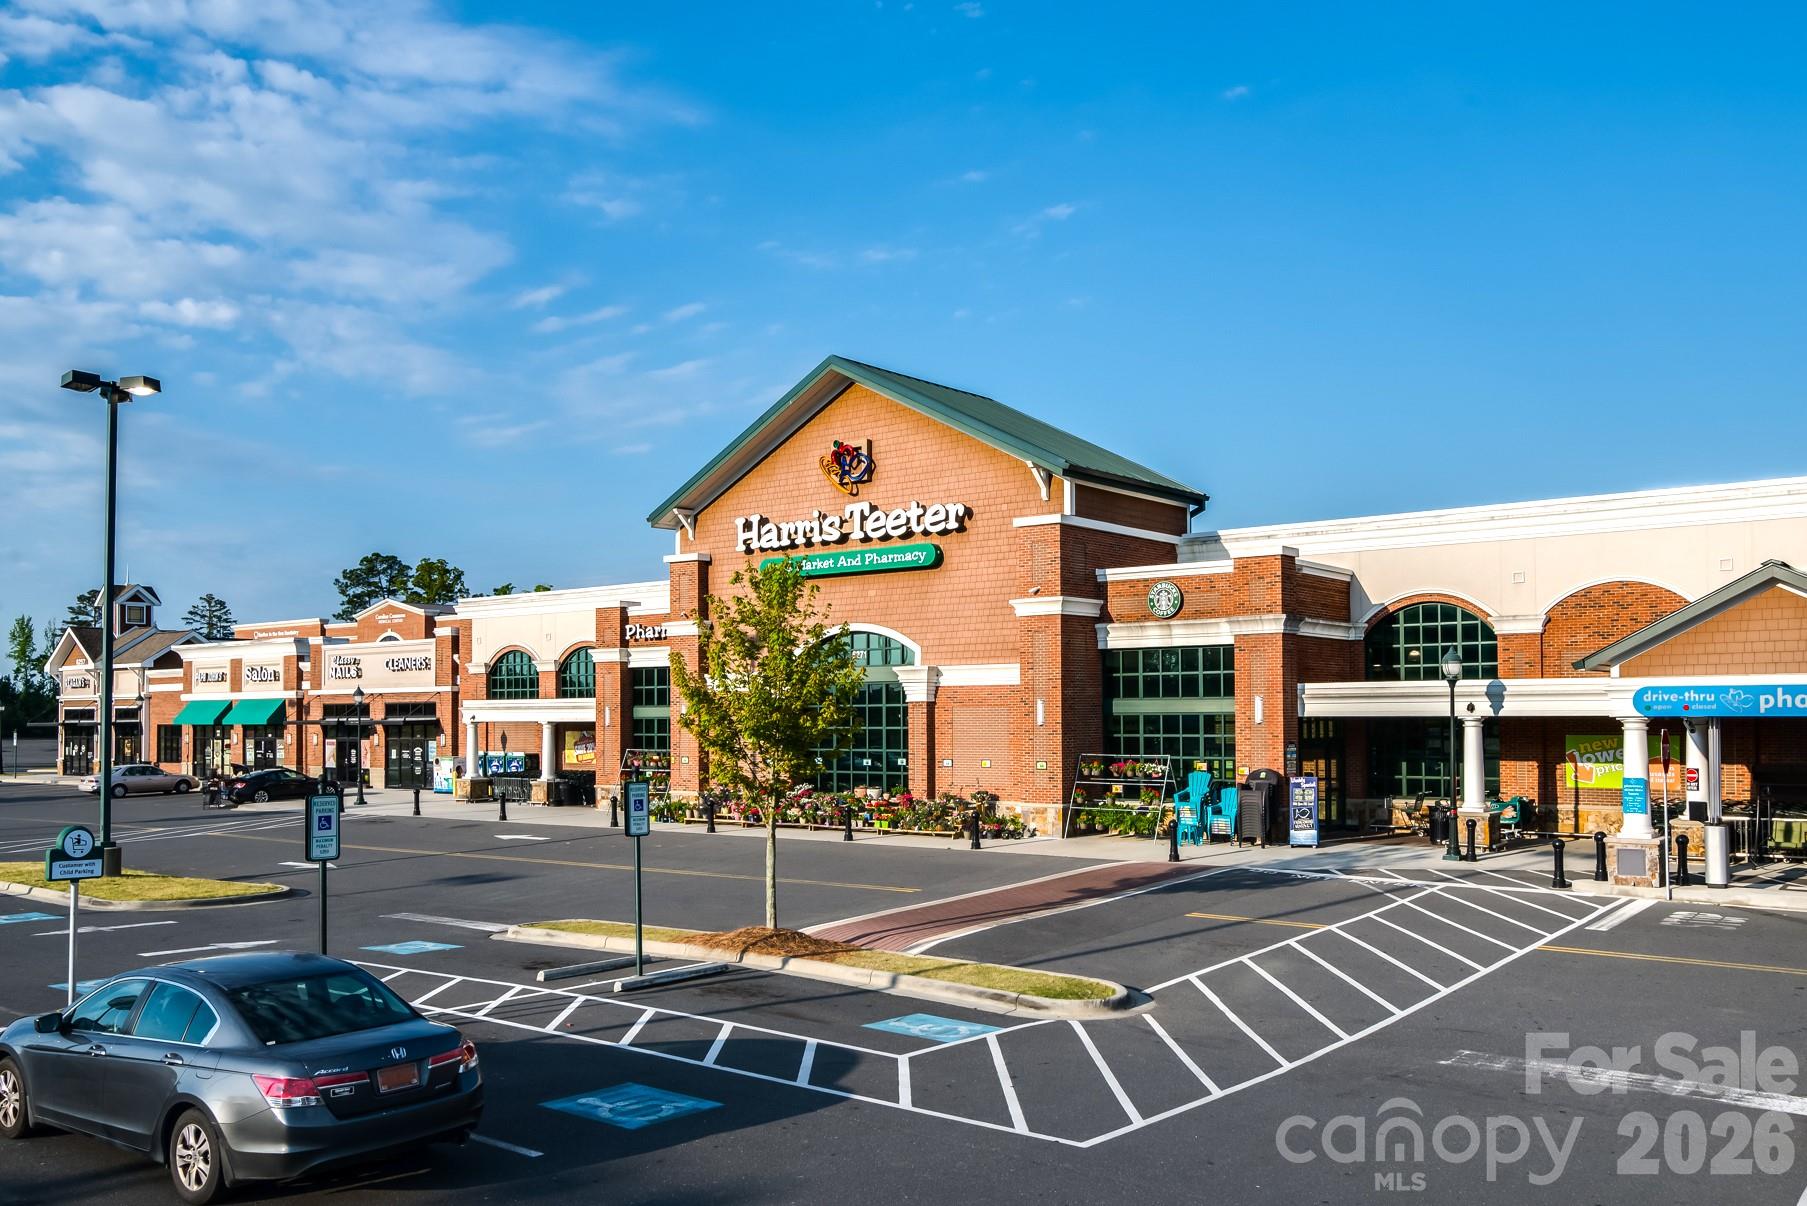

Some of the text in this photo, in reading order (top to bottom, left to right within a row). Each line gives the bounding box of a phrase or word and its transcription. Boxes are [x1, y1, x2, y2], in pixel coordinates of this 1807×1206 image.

[735, 501, 967, 552] Harris Teeter
[837, 554, 862, 567] And
[865, 551, 926, 565] Pharmacy
[1150, 583, 1178, 598] STARBUCKS
[1153, 608, 1175, 616] COFFEE
[384, 657, 429, 670] CLEANERS
[245, 666, 274, 681] Salon
[330, 667, 358, 679] NAILS
[1643, 689, 1715, 702] drive-thru
[1579, 738, 1618, 753] new
